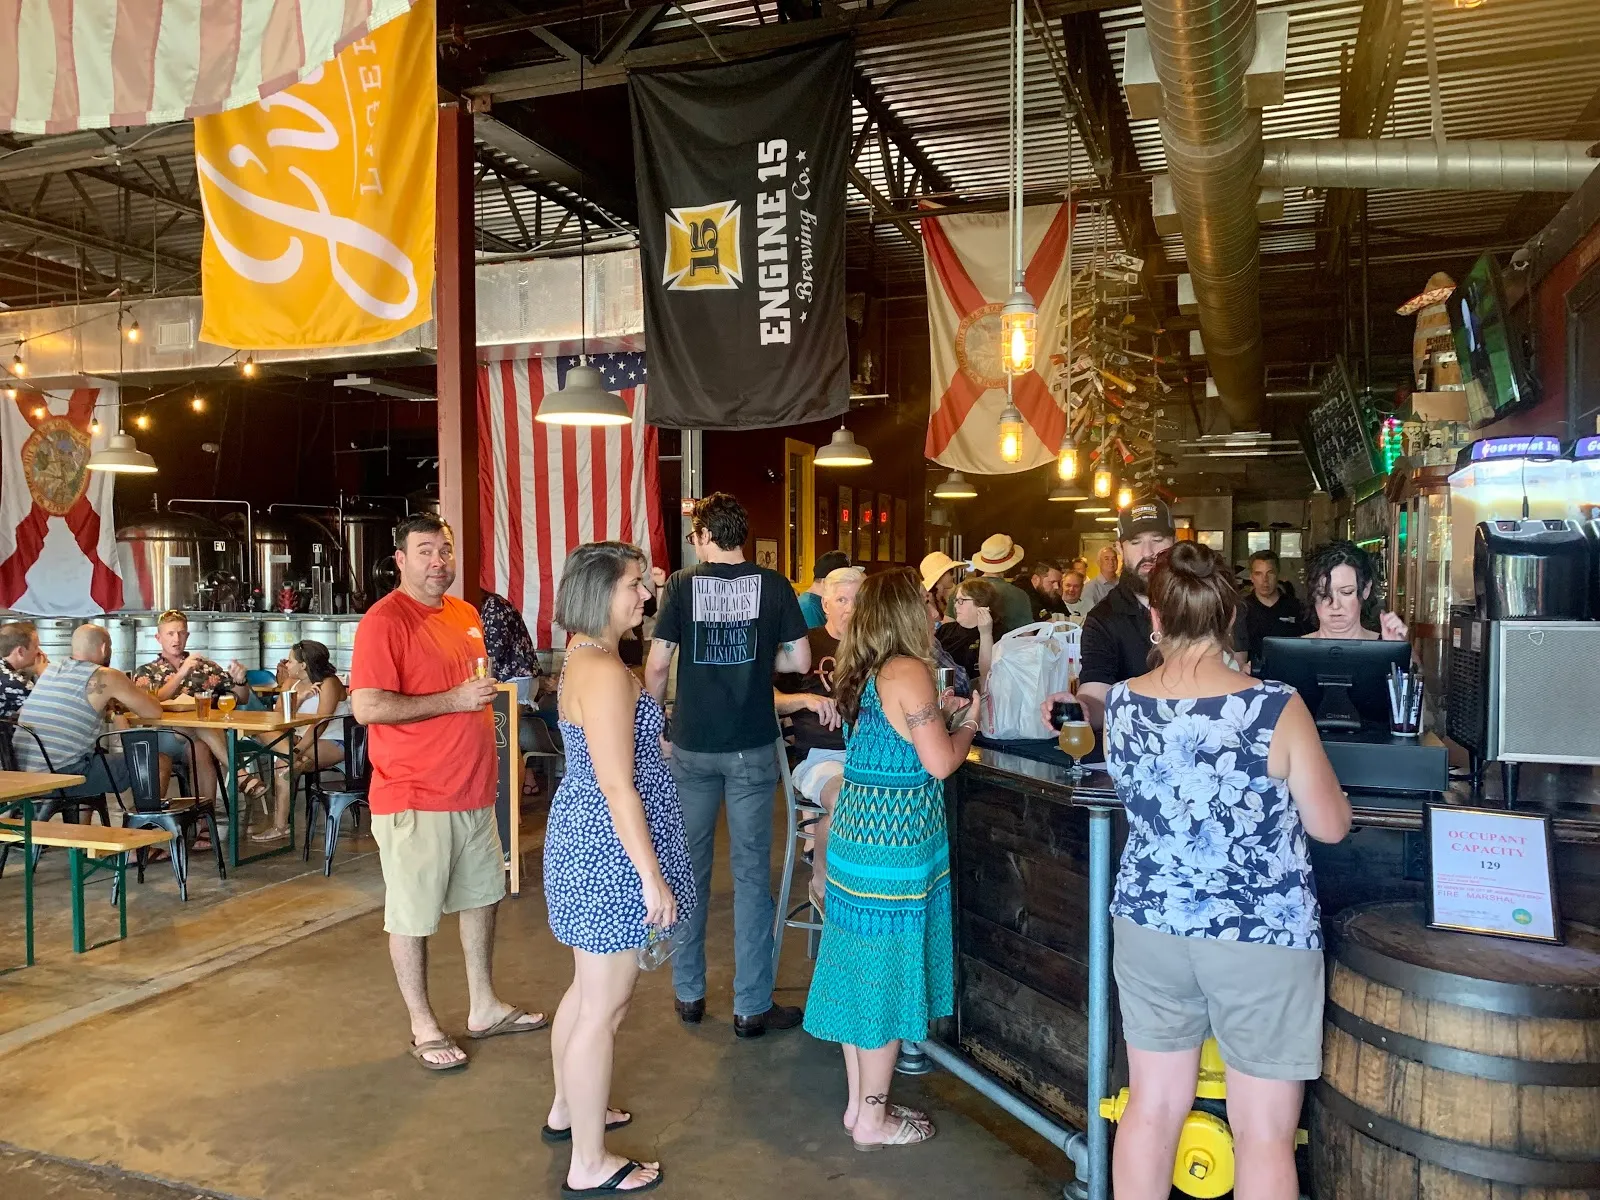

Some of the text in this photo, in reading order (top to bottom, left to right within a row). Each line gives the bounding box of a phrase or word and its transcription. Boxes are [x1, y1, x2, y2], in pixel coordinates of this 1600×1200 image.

[757, 138, 791, 346] ENGINE 15
[791, 166, 818, 303] Brewing Co.
[689, 218, 720, 276] 15
[1482, 441, 1543, 455] Gourmet
[697, 578, 758, 596] ALL COUNTRIES
[703, 594, 751, 612] ALL PLACES
[703, 610, 751, 629] ALL PEOPLE
[706, 628, 748, 646] ALL FACES
[704, 645, 748, 663] ALLSAINTS
[1448, 830, 1527, 845] OCCUPANT
[1451, 842, 1525, 858] CAPACITY
[1480, 860, 1501, 870] 129
[1437, 890, 1459, 898] FIRE
[1466, 892, 1515, 904] MARSHAL
